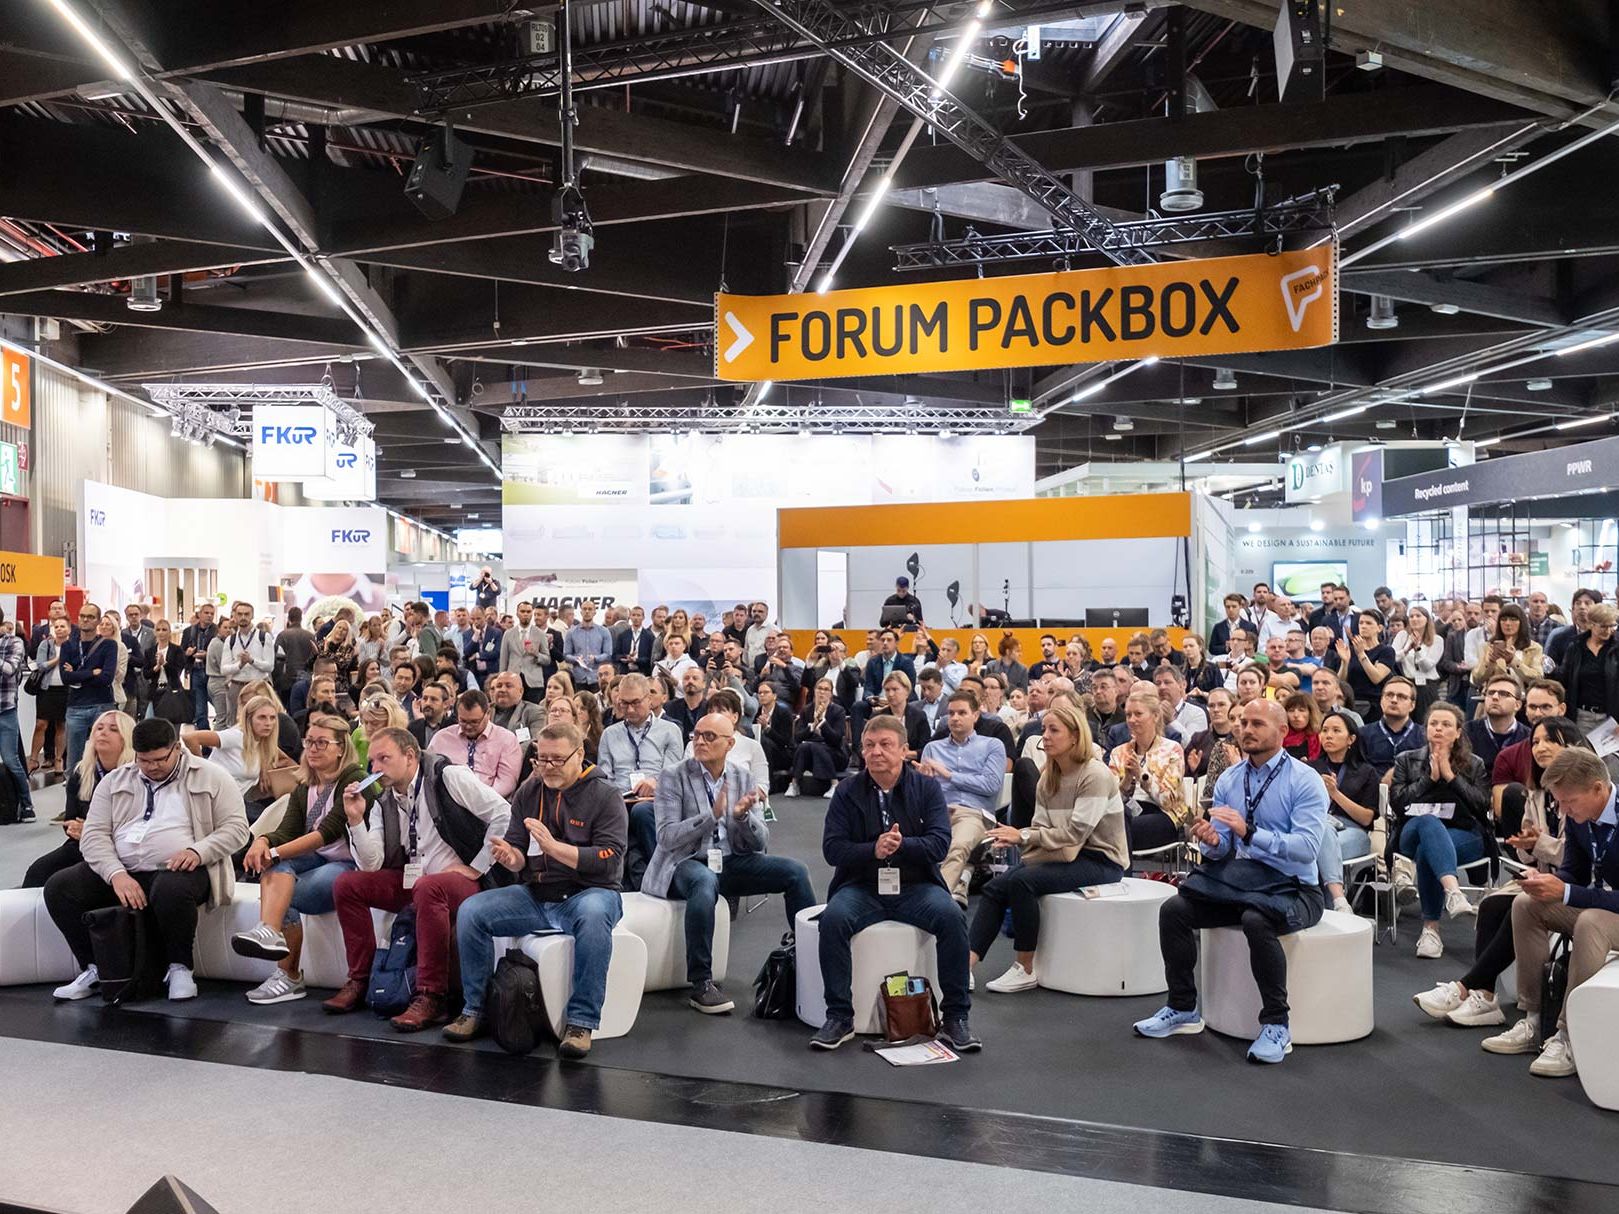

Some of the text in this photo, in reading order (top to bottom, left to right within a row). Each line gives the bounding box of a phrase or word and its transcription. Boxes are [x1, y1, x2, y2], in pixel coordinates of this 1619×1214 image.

[535, 33, 545, 41] 02
[535, 42, 545, 51] 04
[770, 276, 1241, 363] FORUM PACKBOX
[11, 361, 21, 412] 5
[1566, 459, 1593, 476] PPWR
[1360, 477, 1374, 496] kp
[1414, 480, 1469, 500] Recycled content
[1288, 539, 1294, 547] A
[1295, 539, 1346, 547] SUSTAINABLE
[1347, 538, 1375, 547] FUTURE
[0, 563, 16, 583] OSK
